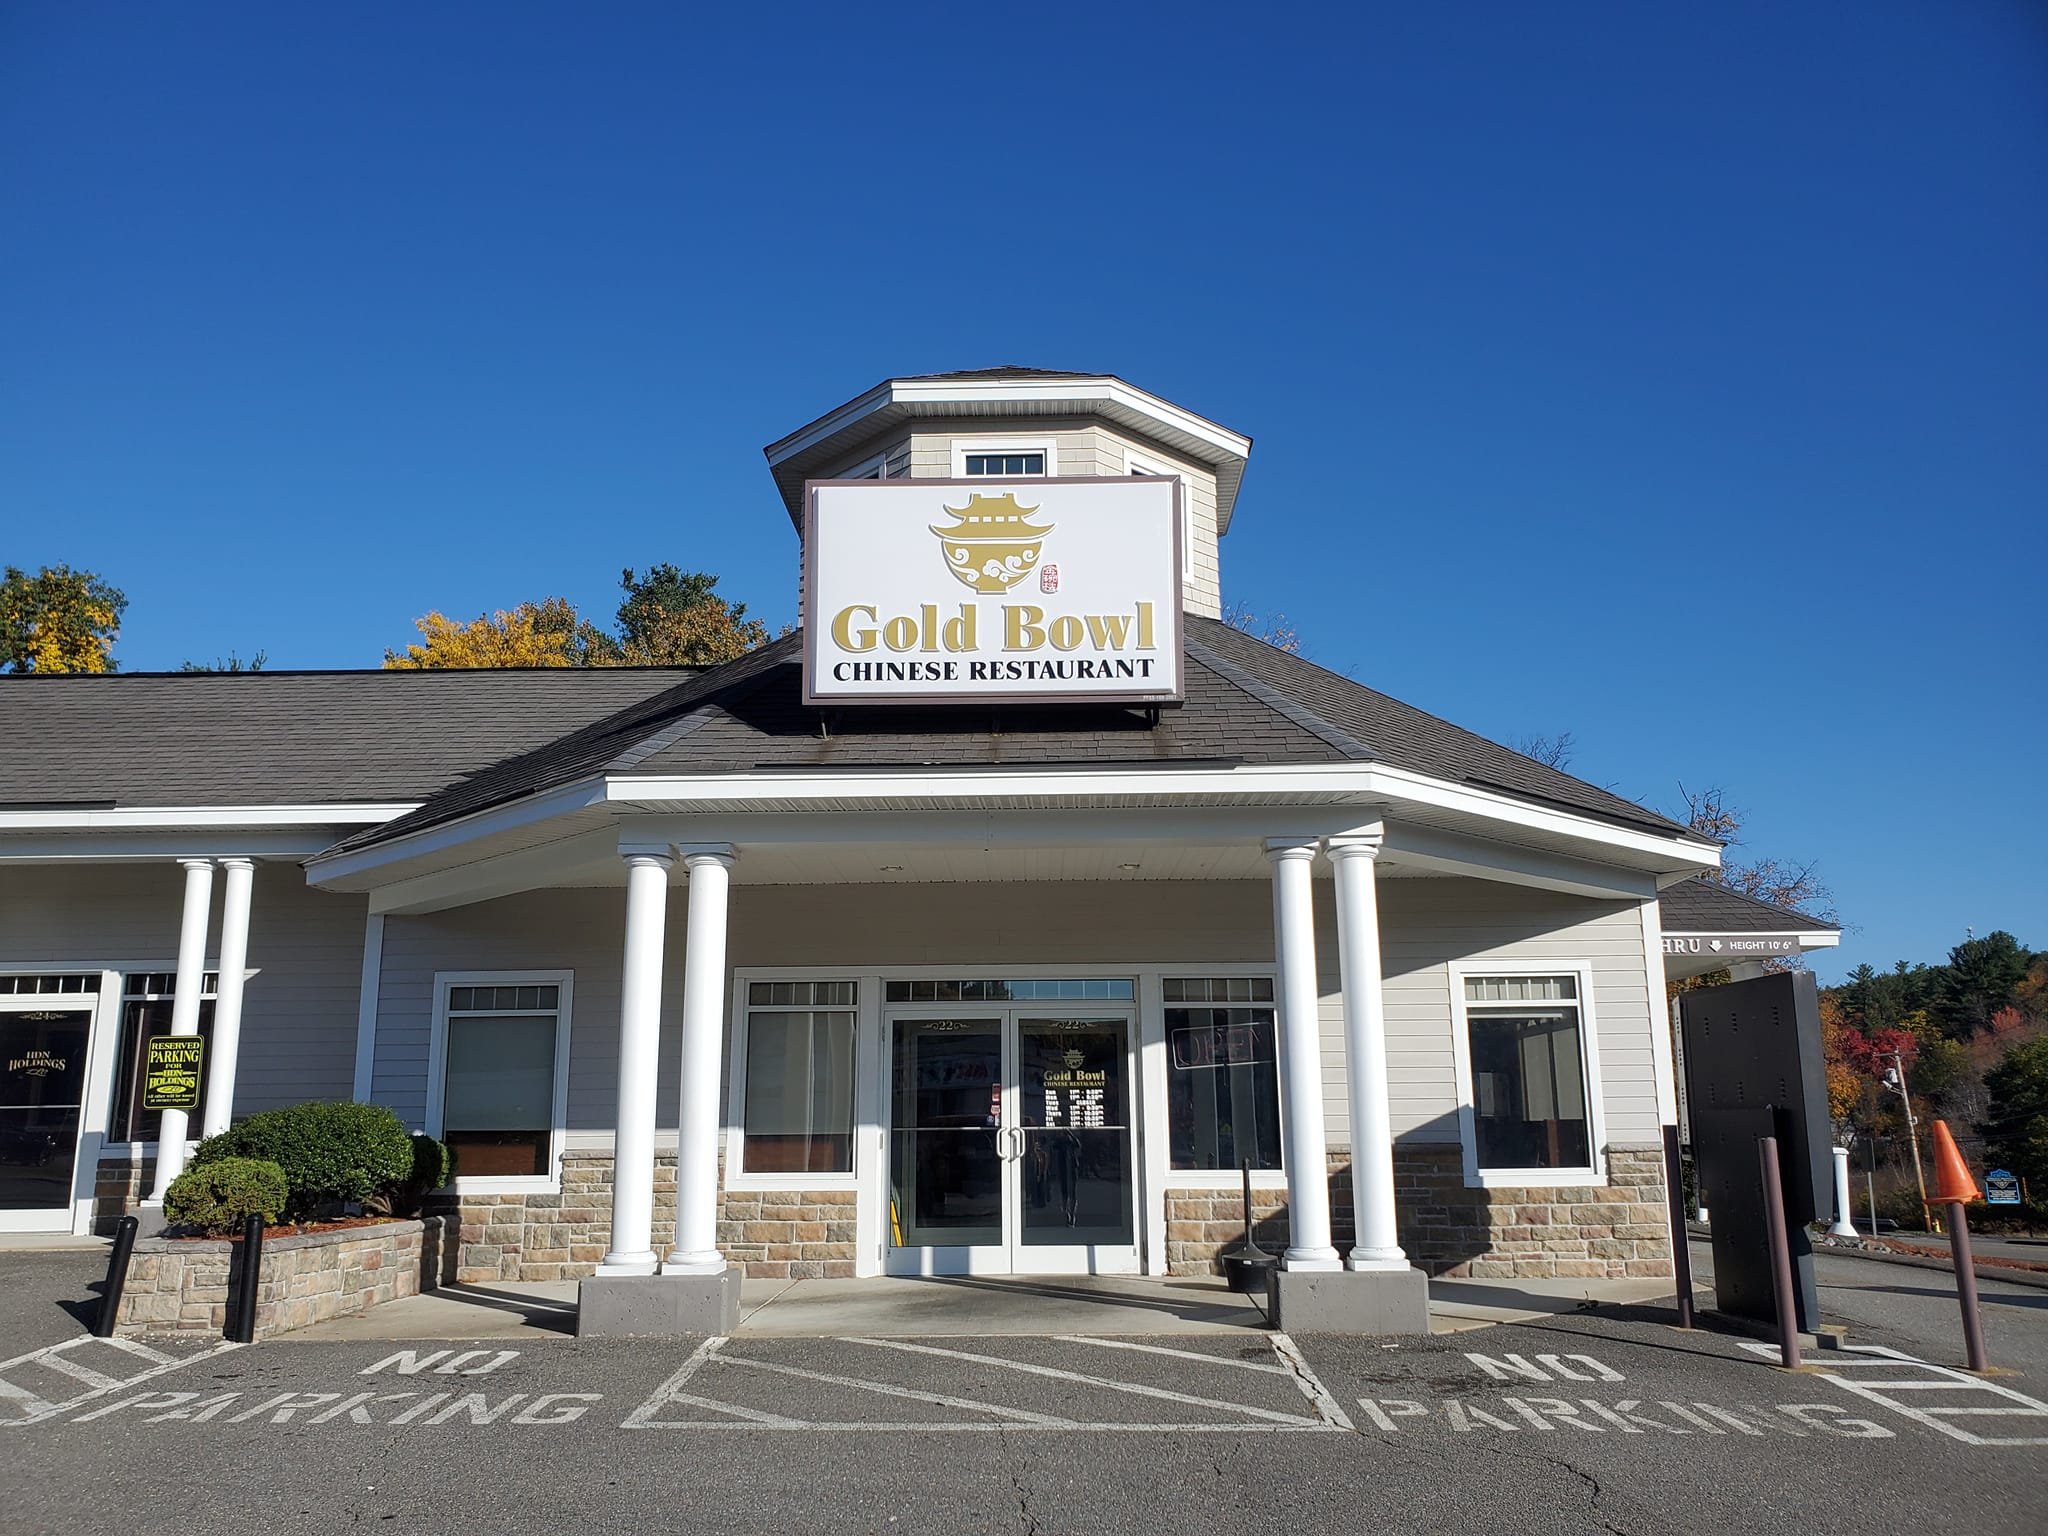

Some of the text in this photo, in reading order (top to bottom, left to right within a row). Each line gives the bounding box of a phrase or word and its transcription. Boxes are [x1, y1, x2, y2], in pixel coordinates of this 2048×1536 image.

[831, 601, 1157, 653] Gold Bowl
[833, 658, 1155, 682] CHINESE RESTAURANT
[1730, 941, 1765, 950] HEIGHT
[938, 1021, 954, 1031] 22
[1065, 1020, 1080, 1030] 22
[151, 1042, 200, 1050] RESERVED
[27, 1051, 51, 1059] HDN
[150, 1050, 199, 1063] PARKING
[9, 1058, 66, 1072] HOLDINGS
[1043, 1069, 1105, 1081] Gold Bowl
[149, 1076, 196, 1089] HOLDINGS
[356, 1350, 522, 1375] NO
[1463, 1353, 1627, 1382] NO
[70, 1391, 604, 1426] PARKING
[1354, 1398, 1897, 1439] PARKING
